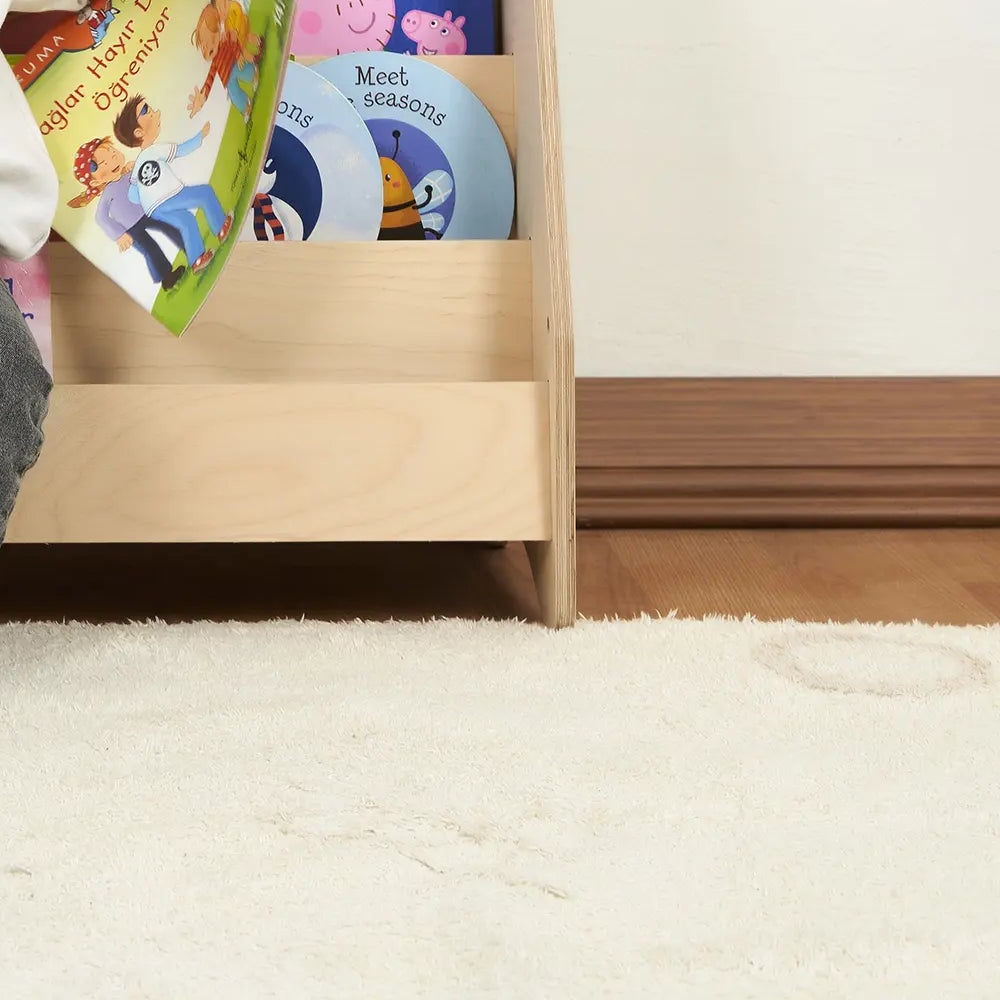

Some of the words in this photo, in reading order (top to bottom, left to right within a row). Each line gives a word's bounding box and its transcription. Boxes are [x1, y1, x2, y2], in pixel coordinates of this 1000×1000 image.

[16, 35, 65, 82] UMA
[87, 19, 134, 79] Hayır
[91, 6, 169, 111] Öğreniyor
[355, 66, 408, 86] Meet
[364, 92, 447, 126] seasons
